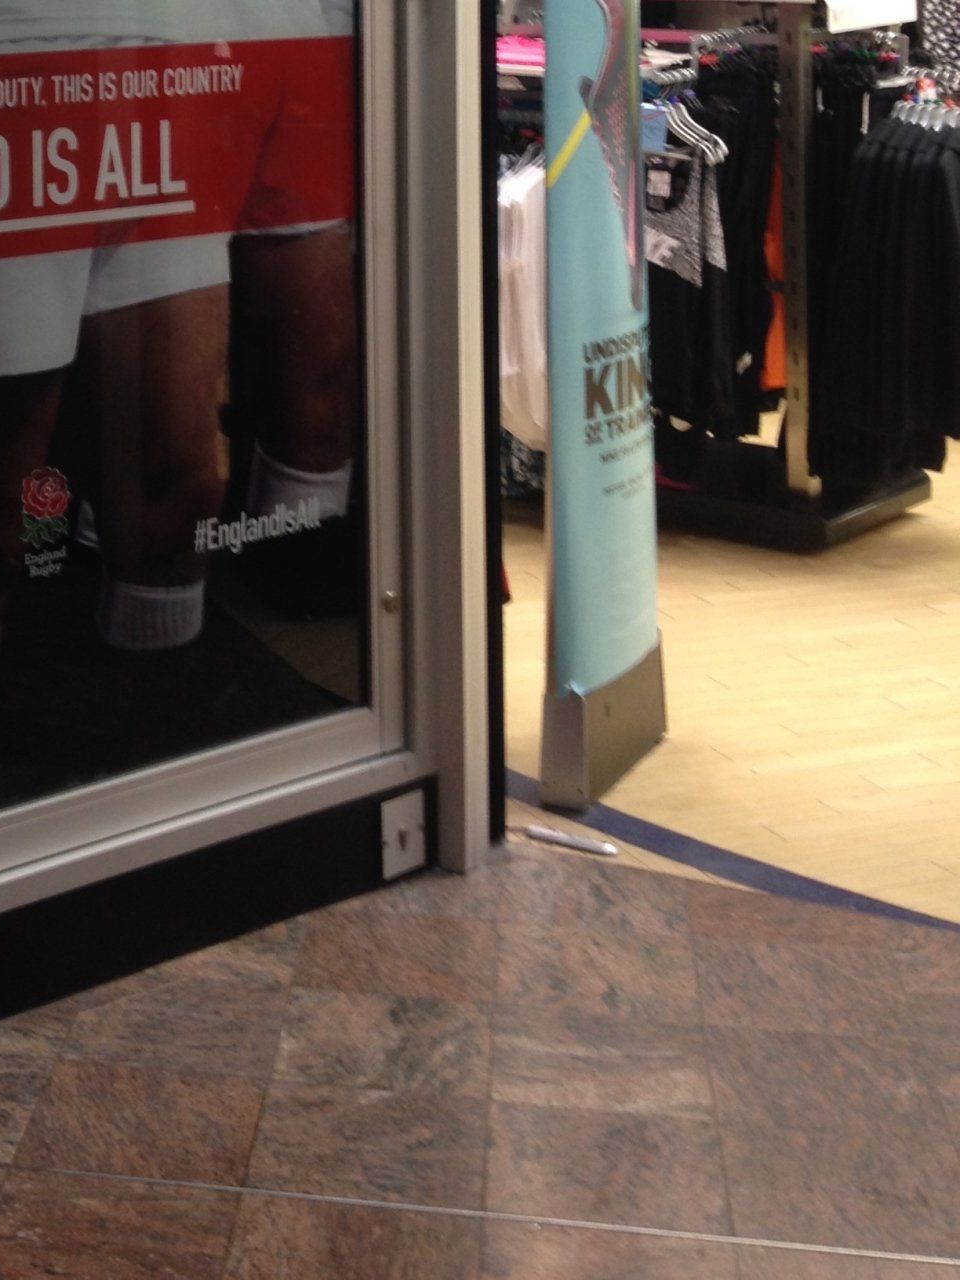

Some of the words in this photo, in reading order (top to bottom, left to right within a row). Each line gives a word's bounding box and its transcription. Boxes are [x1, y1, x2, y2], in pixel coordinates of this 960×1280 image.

[51, 73, 94, 104] THIS
[98, 71, 118, 101] IS
[121, 69, 159, 99] OUR
[163, 63, 245, 97] COUNTRY
[32, 127, 79, 208] IS
[94, 120, 188, 201] ALL
[193, 496, 321, 554] #EnglandIsAll
[24, 544, 67, 566] England
[29, 560, 62, 578] Rugby
